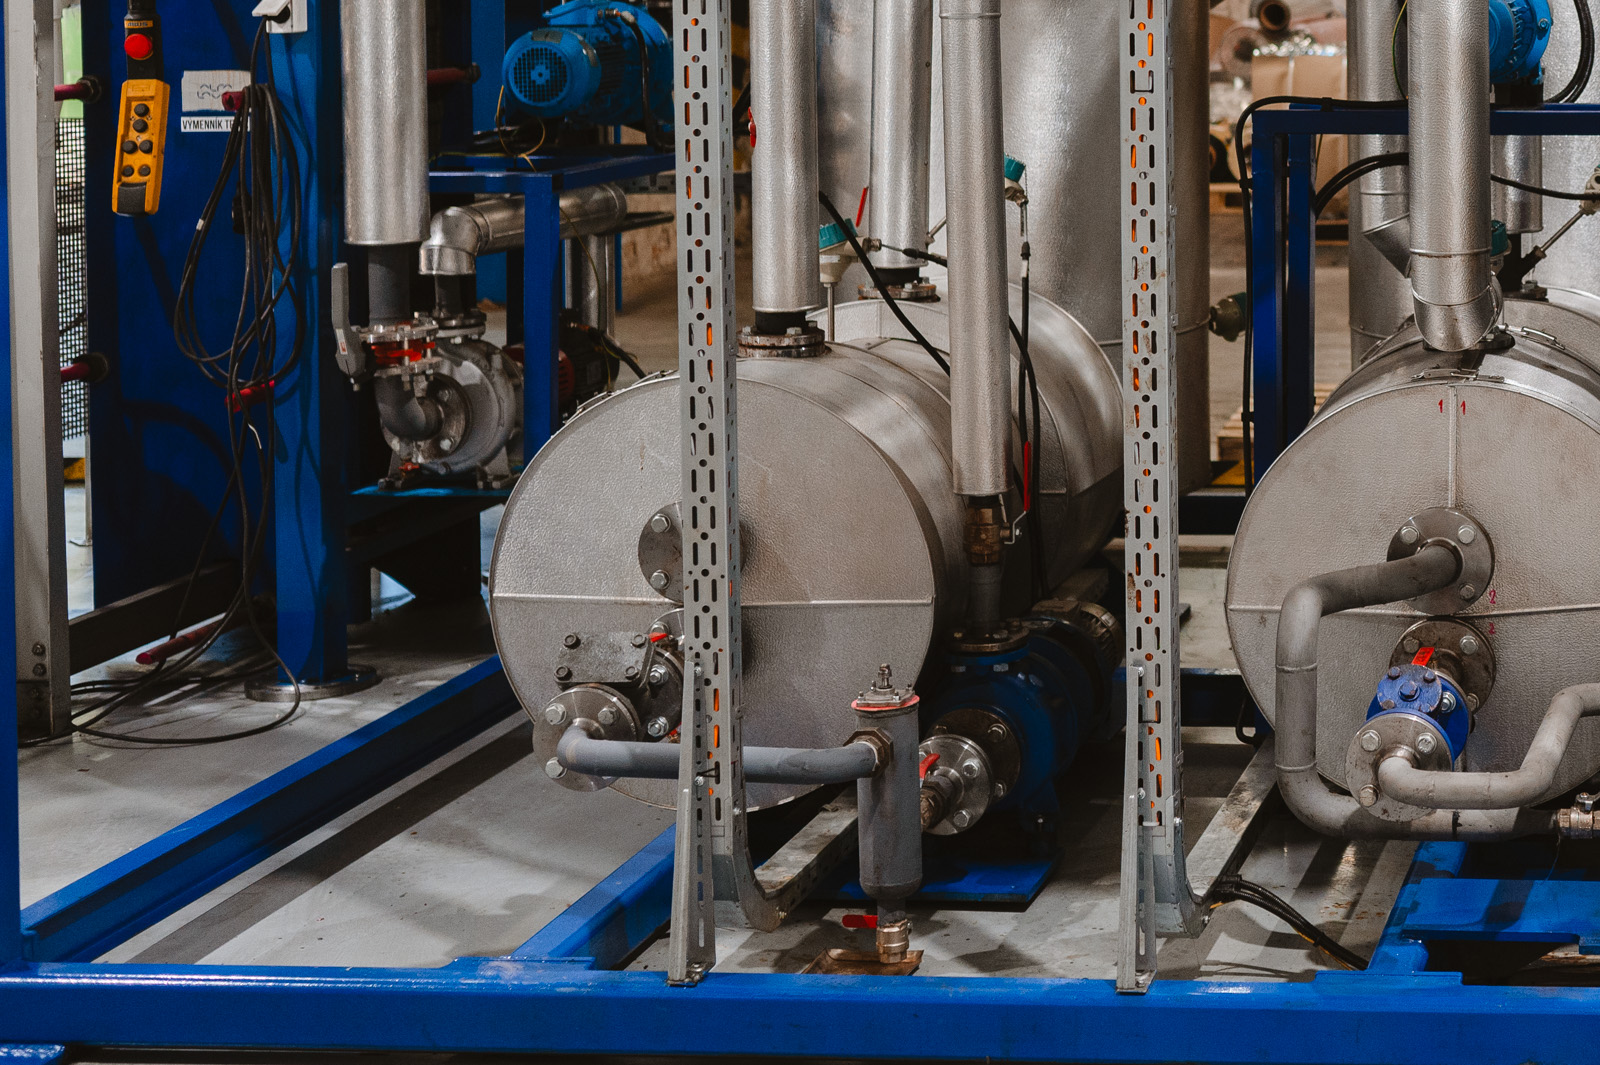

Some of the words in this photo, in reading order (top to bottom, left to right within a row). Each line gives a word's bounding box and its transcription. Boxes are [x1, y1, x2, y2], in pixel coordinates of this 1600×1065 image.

[182, 116, 223, 130] VÝMENNÍK
[1438, 399, 1443, 414] 1
[1460, 400, 1466, 416] 1
[1488, 588, 1497, 605] 2
